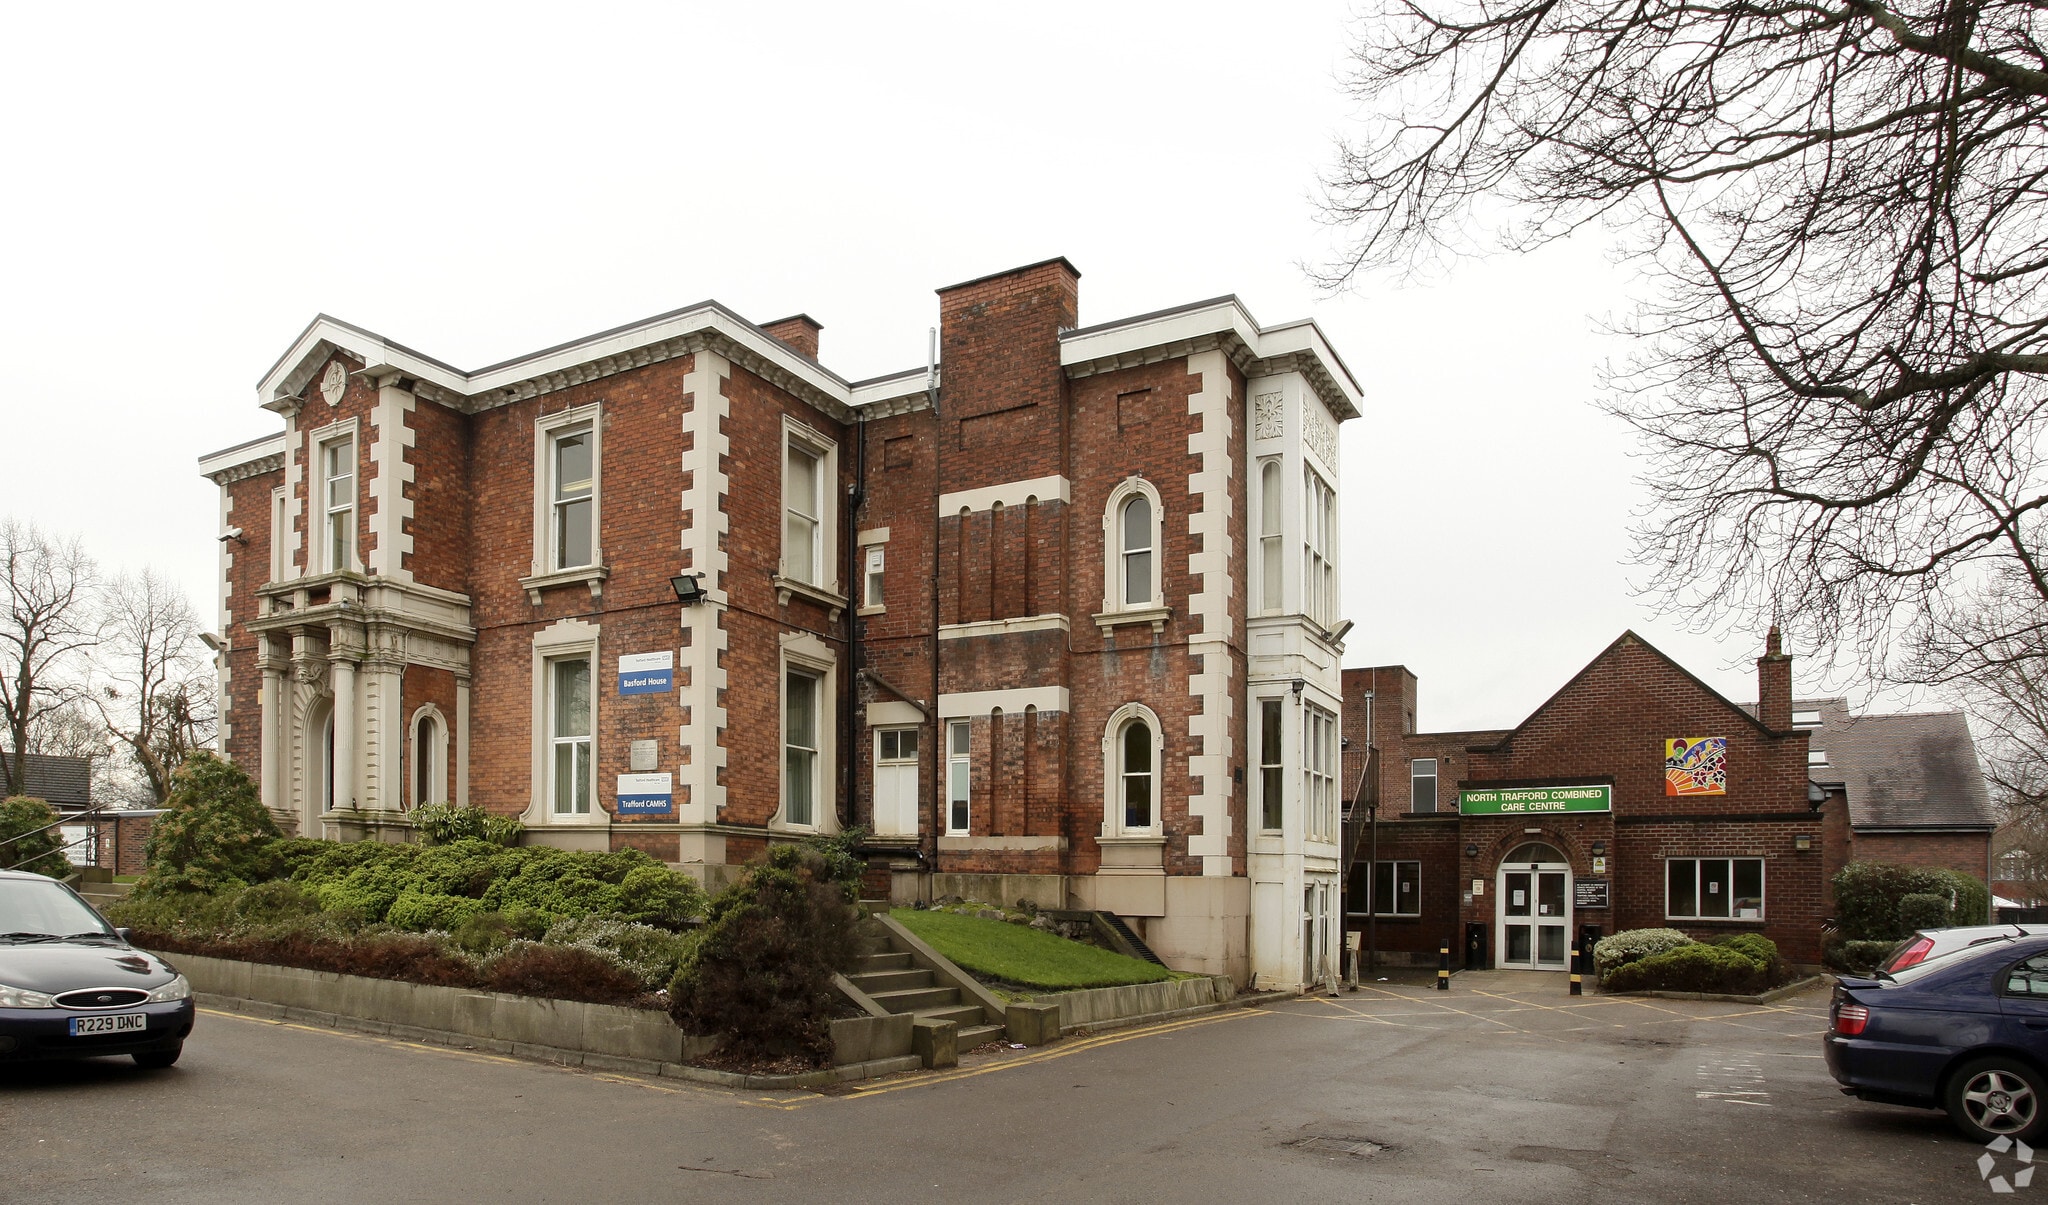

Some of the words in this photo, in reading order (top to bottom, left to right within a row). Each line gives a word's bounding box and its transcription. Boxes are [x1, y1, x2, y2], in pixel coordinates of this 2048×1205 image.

[624, 678, 646, 688] Basford
[1466, 794, 1497, 802] NORTH
[1500, 791, 1548, 801] TRAFFORD
[1551, 790, 1602, 800] COMBINED
[1501, 803, 1525, 812] CARE
[1529, 802, 1566, 810] CENTRE
[77, 1017, 114, 1032] R229
[118, 1015, 142, 1030] DNC
